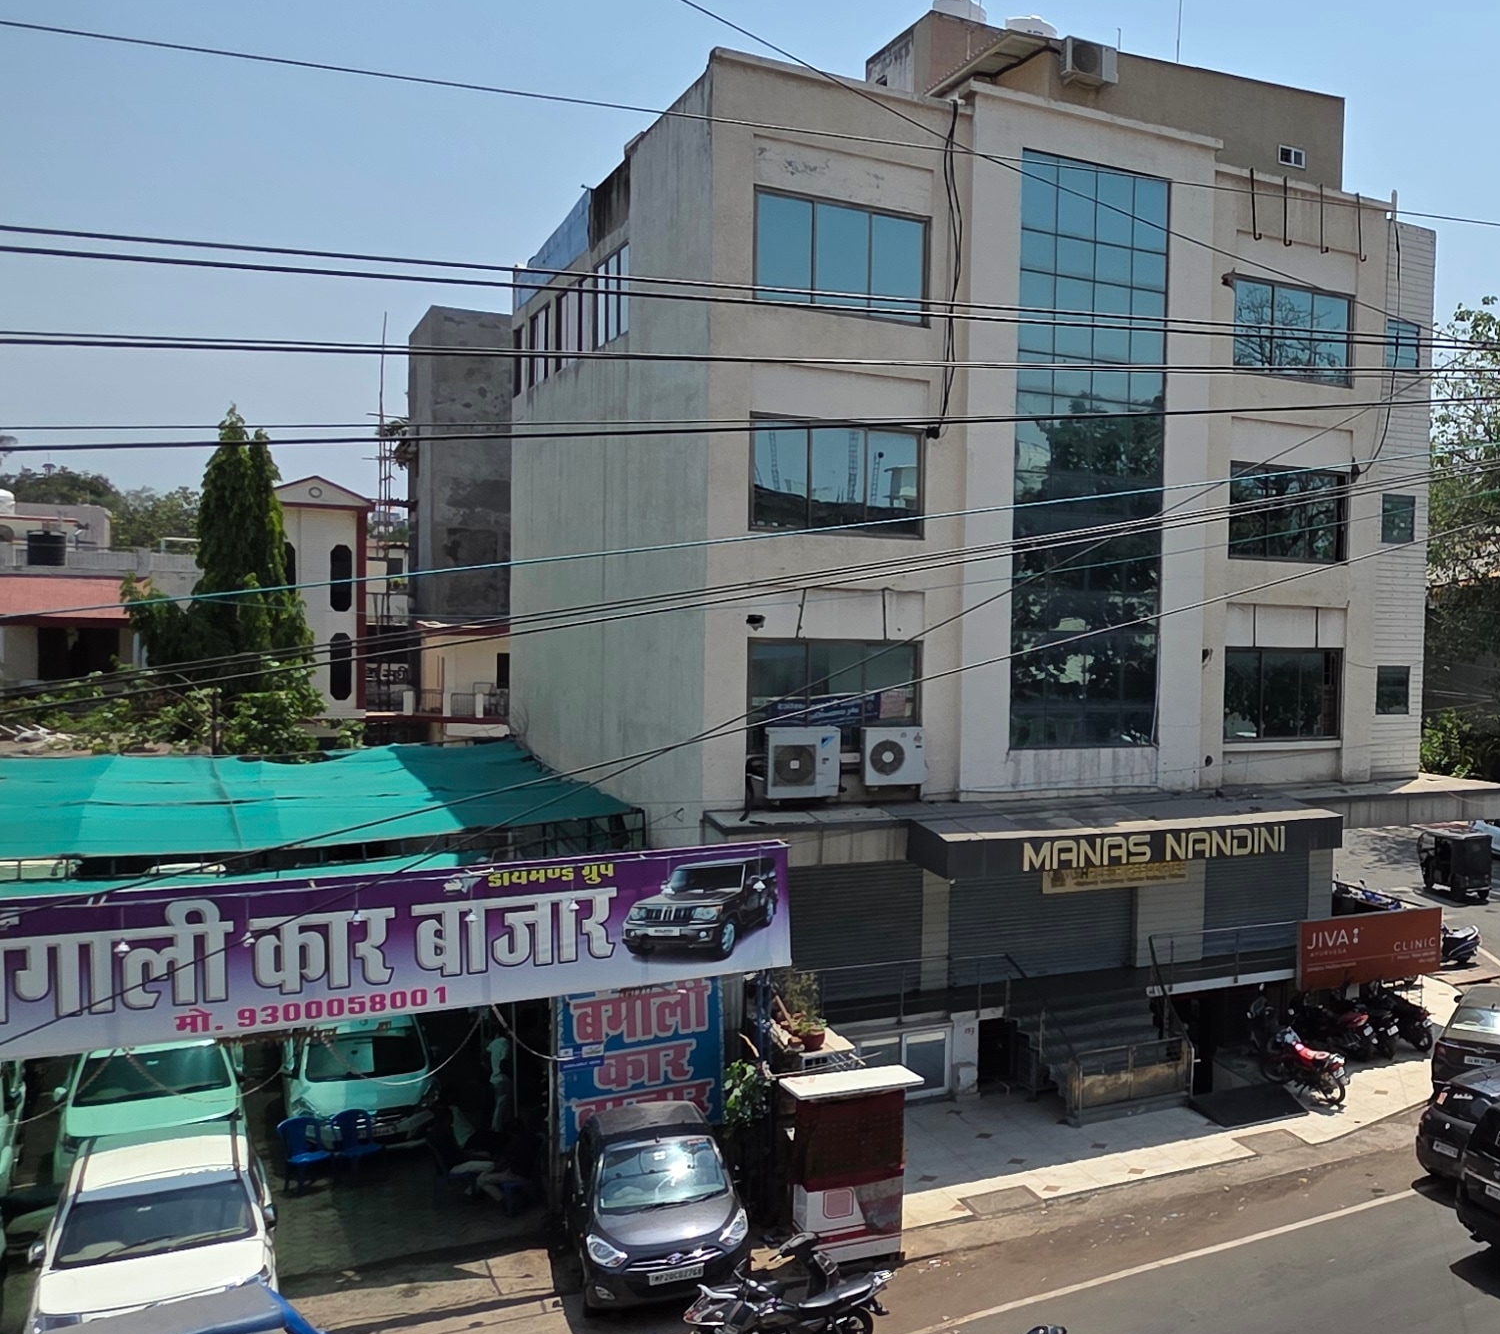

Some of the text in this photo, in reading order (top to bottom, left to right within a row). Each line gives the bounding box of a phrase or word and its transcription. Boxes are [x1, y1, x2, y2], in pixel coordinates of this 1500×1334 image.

[1023, 826, 1286, 871] MANAS NANDINI
[581, 863, 615, 885] ग्रुप
[250, 907, 395, 994] कार
[412, 887, 617, 977] बाजार
[1307, 929, 1349, 949] JIVA
[1394, 937, 1436, 952] CLINIC
[237, 986, 447, 1028] 9300058001
[597, 1042, 694, 1088] कार
